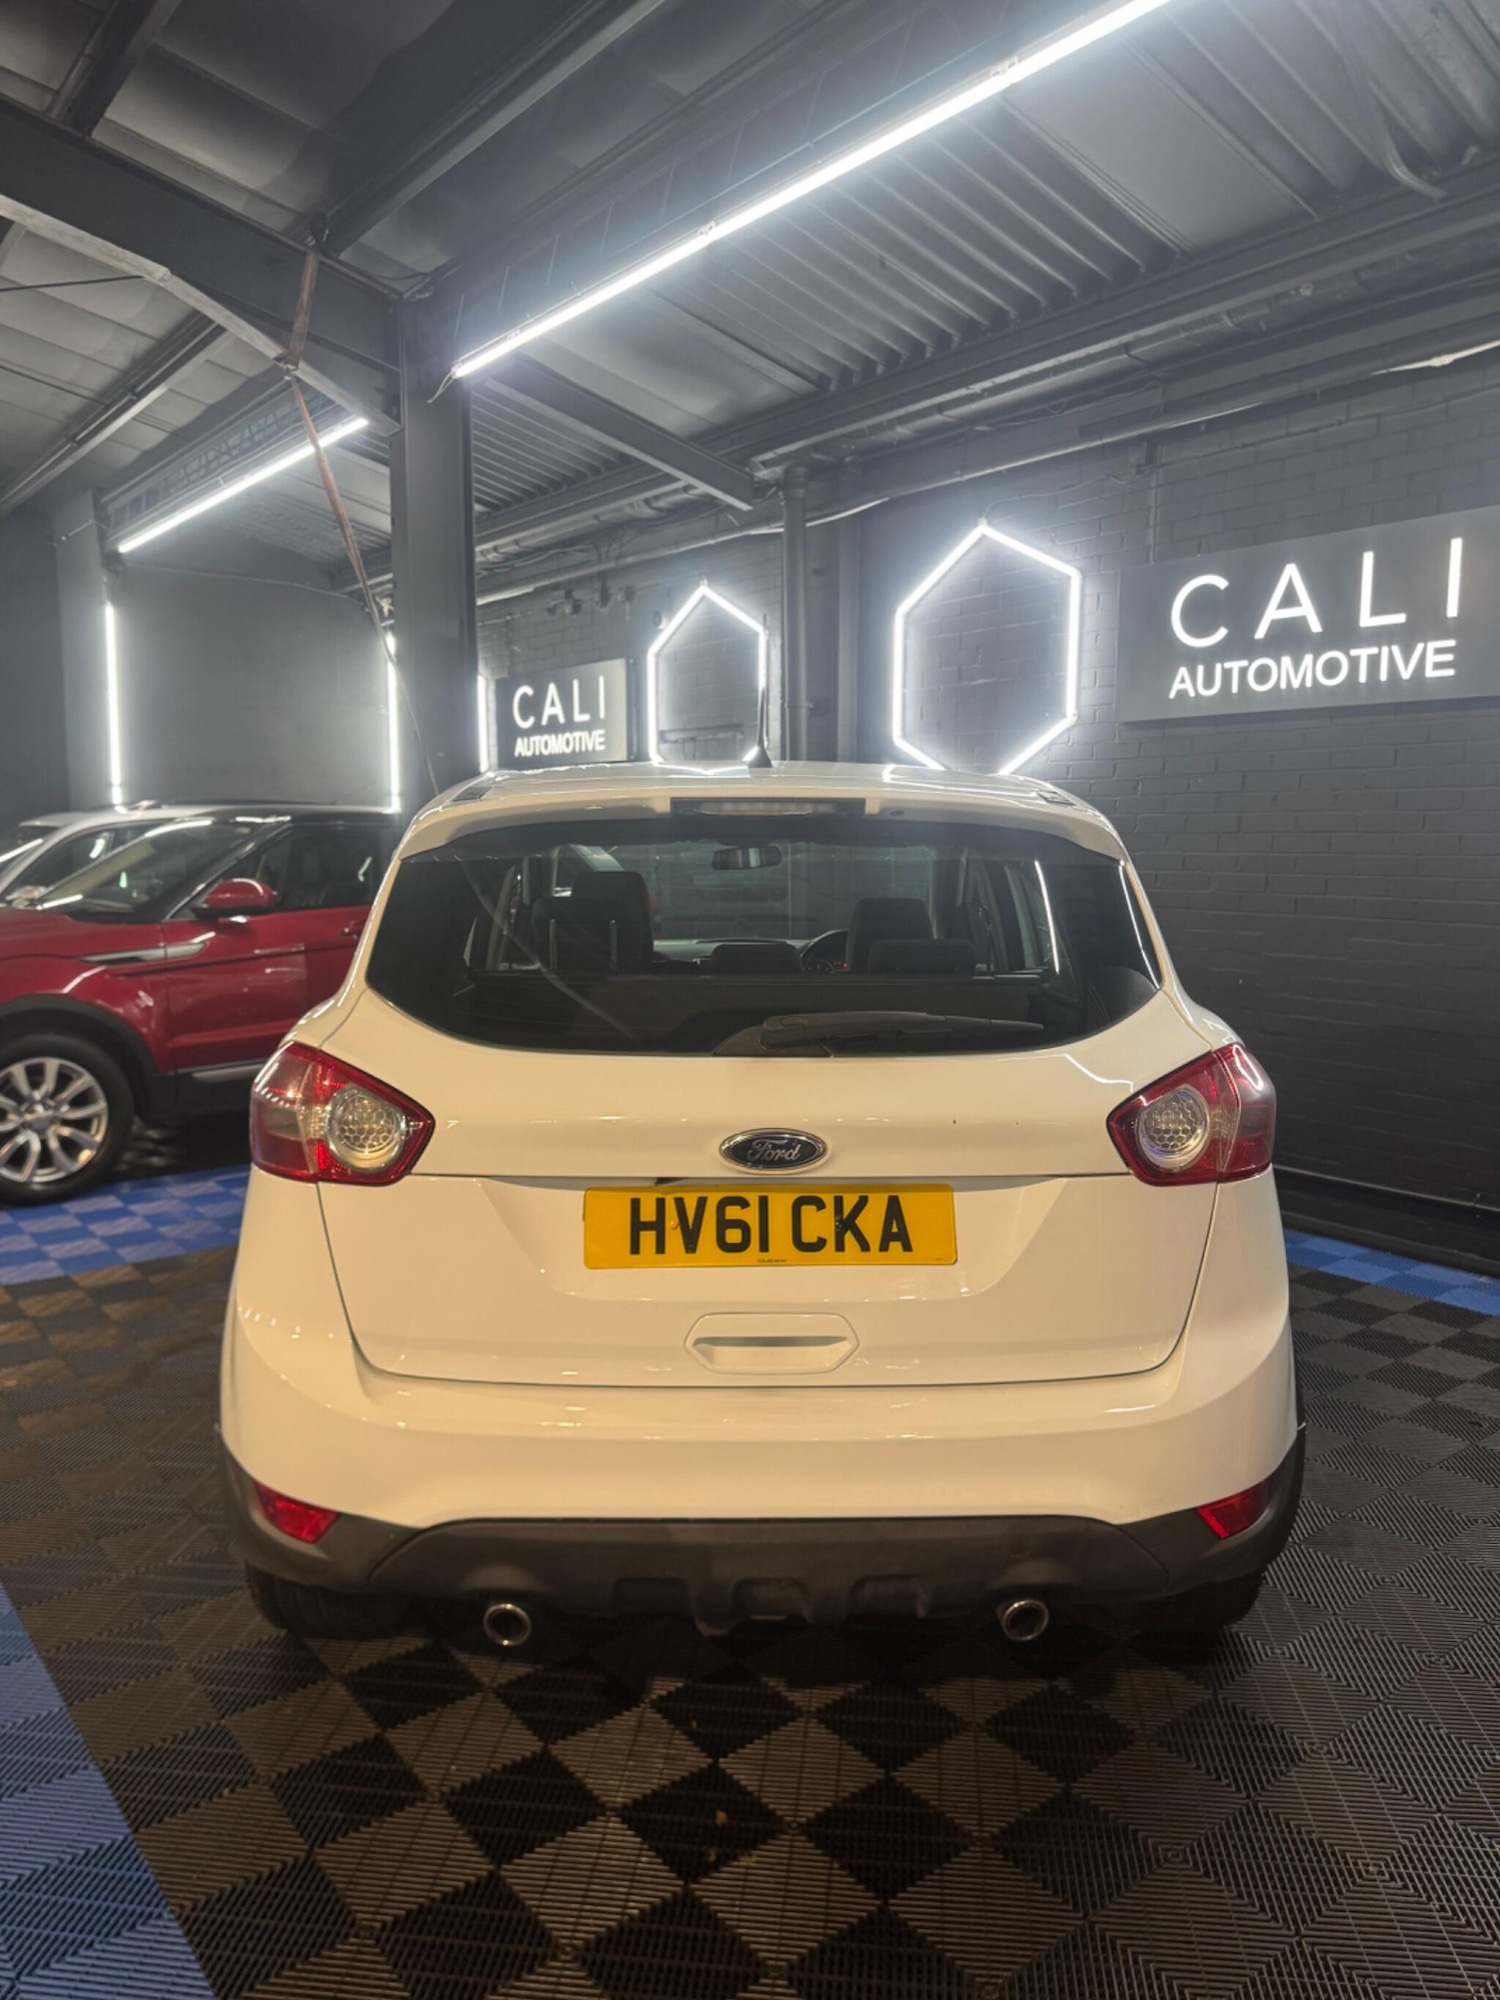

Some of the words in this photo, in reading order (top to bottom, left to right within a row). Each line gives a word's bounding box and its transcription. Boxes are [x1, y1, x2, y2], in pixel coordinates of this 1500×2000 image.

[1170, 537, 1463, 649] CALI
[1168, 639, 1457, 699] AUTOMOTIVE
[512, 674, 606, 729] CALI
[514, 729, 606, 757] AUTOMOTIVE
[746, 1138, 802, 1161] Ford
[629, 1195, 770, 1255] HV61
[791, 1194, 913, 1253] CKA
